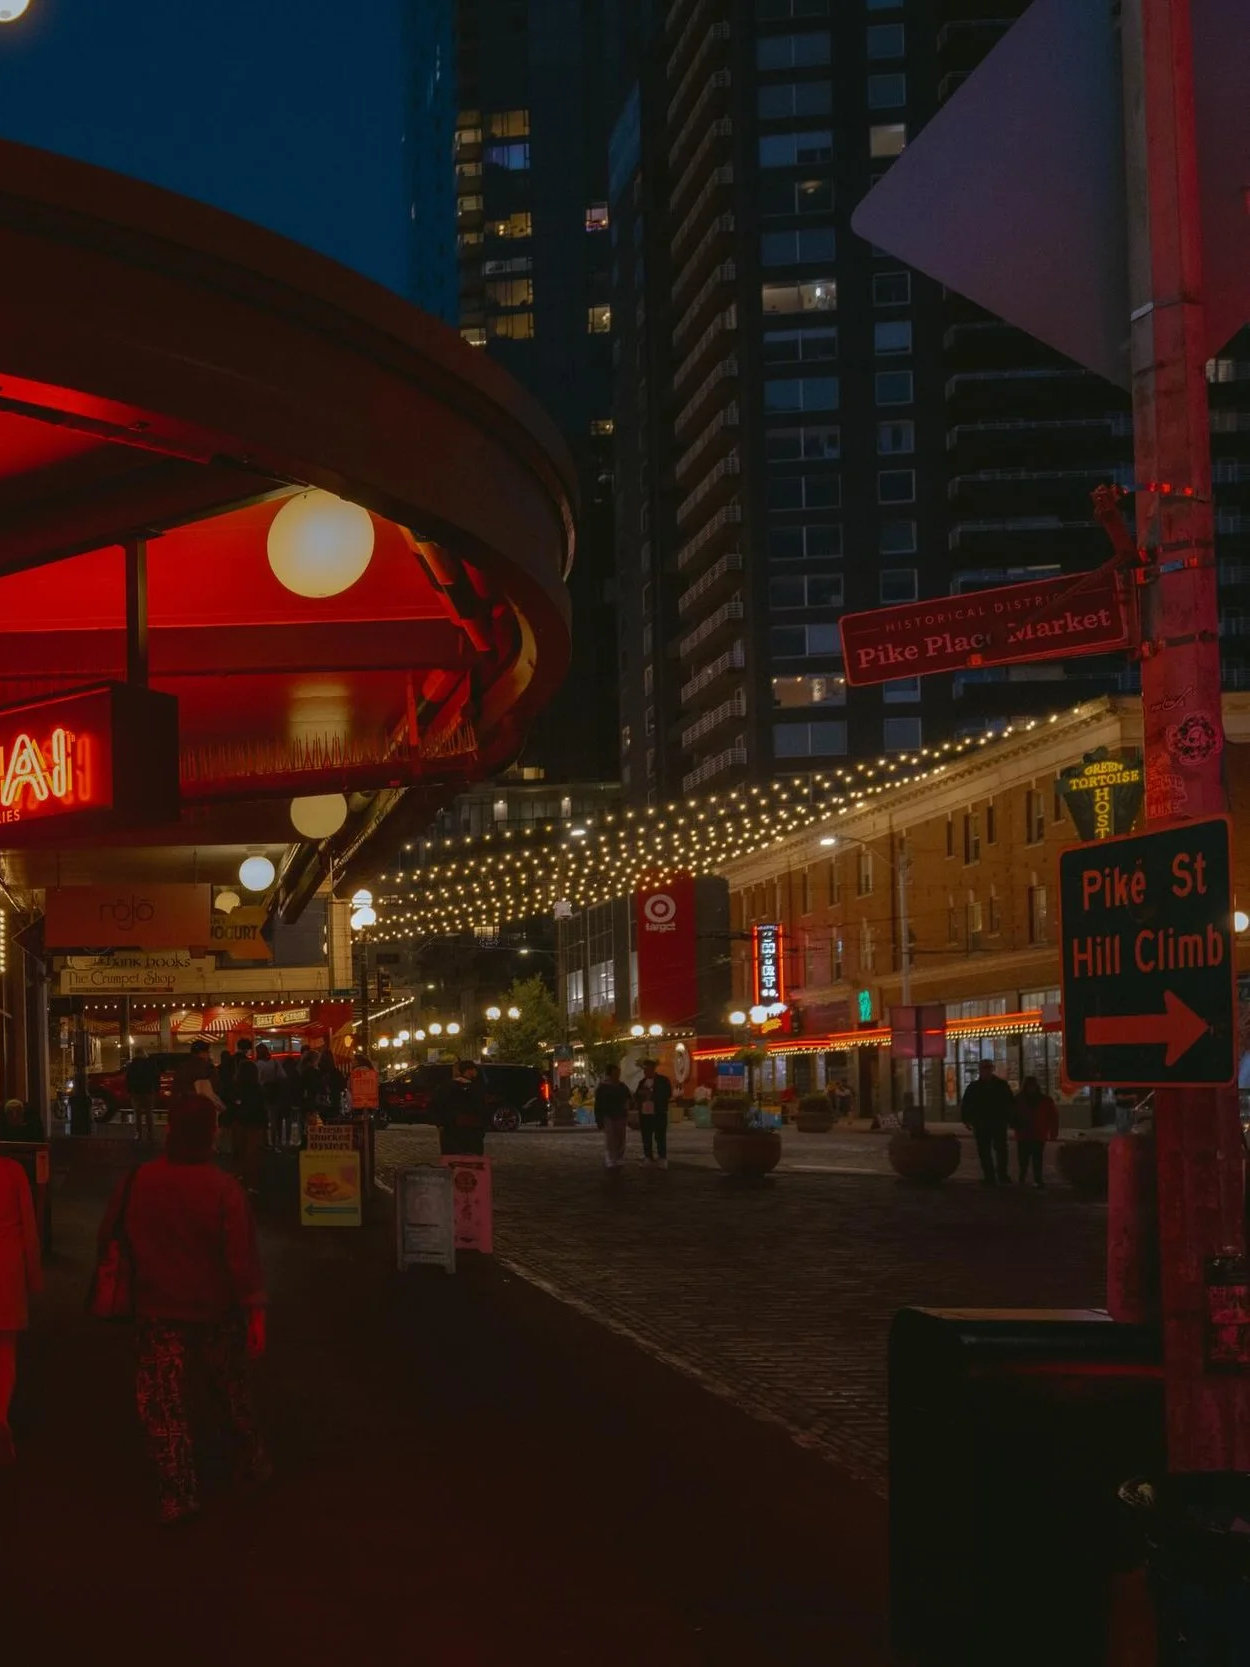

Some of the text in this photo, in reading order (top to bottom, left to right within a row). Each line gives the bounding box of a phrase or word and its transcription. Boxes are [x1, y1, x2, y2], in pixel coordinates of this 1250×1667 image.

[886, 593, 1061, 632] HISTORICAL DISTRIC
[857, 642, 919, 668] Pike
[1007, 608, 1112, 644] Market
[1084, 761, 1124, 776] GREEN
[1070, 769, 1139, 790] TORTOISE
[1082, 852, 1207, 911] Pike St
[210, 924, 258, 941] OGURT
[645, 921, 676, 933] target
[1072, 923, 1224, 978] Hill Climb
[68, 970, 176, 988] The Crumpet Shop
